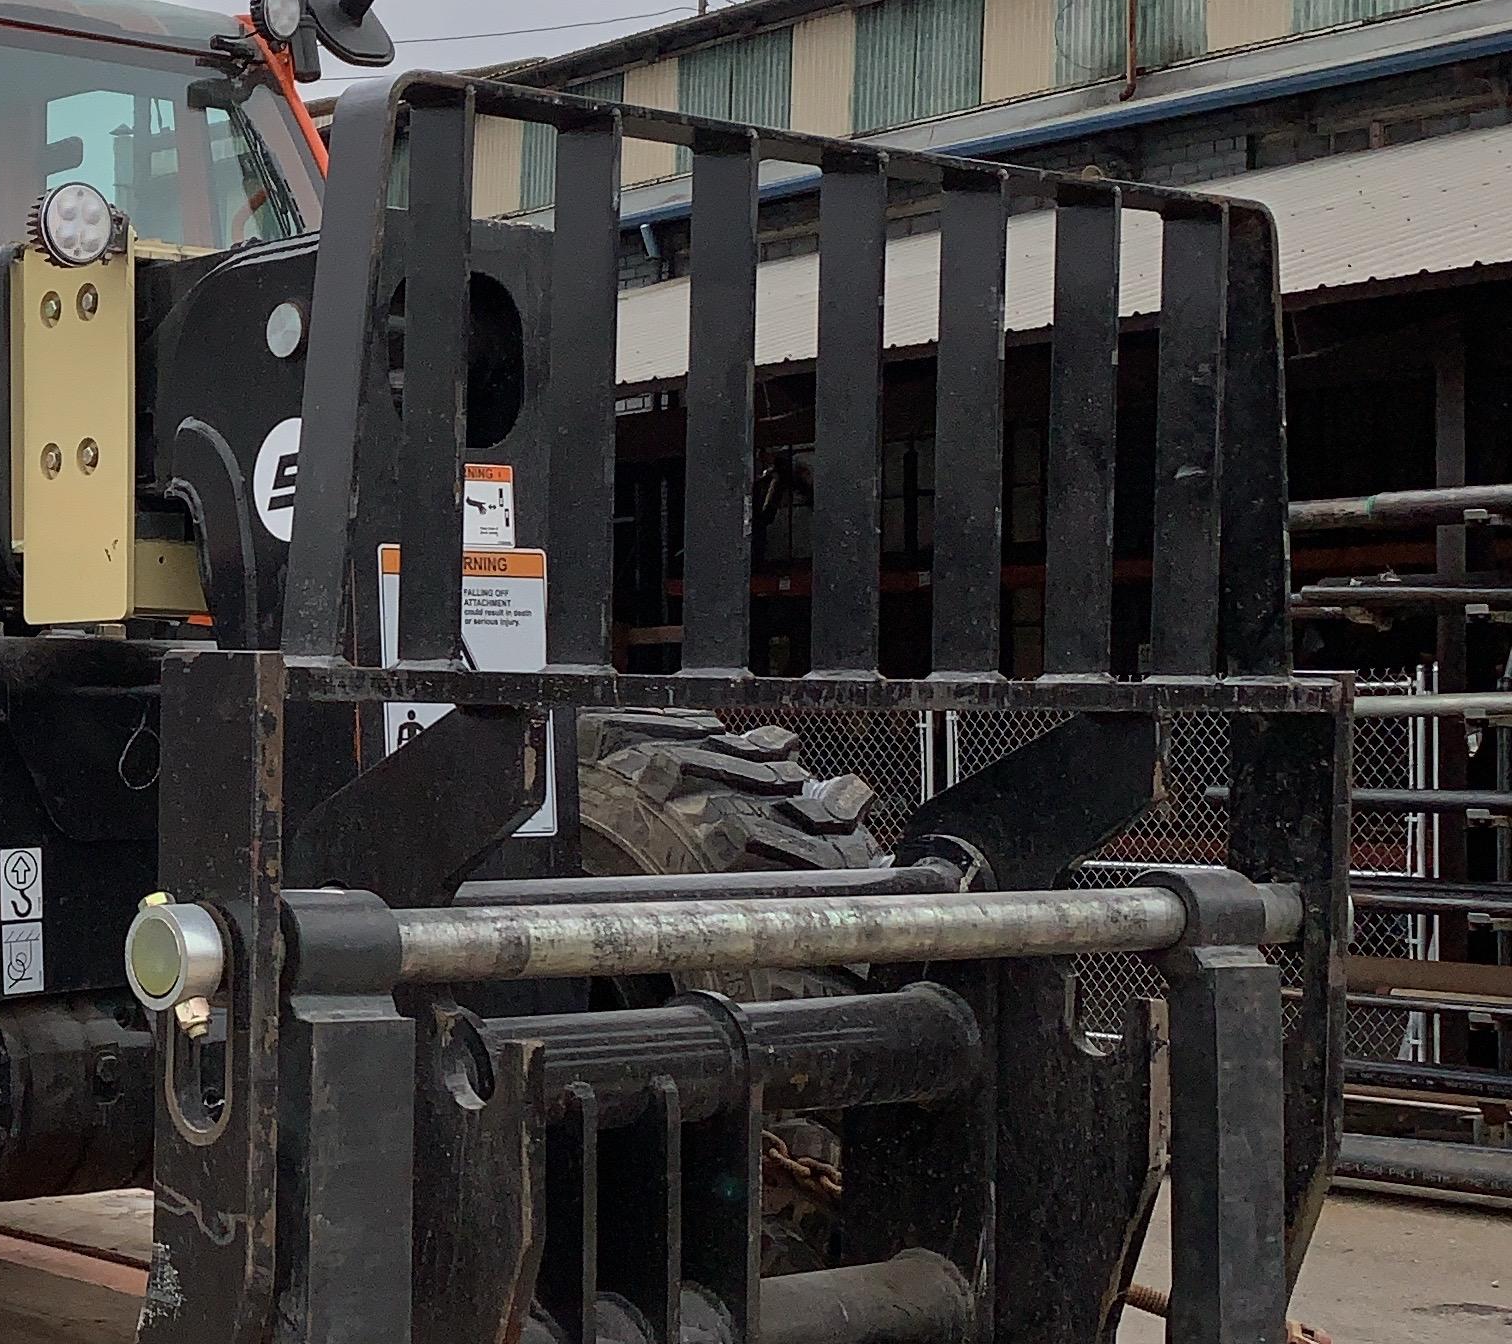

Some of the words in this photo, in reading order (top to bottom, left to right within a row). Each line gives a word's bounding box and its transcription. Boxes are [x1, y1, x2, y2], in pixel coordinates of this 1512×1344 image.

[464, 557, 508, 572] RNING
[463, 588, 493, 597] FALLING
[494, 588, 509, 597] OFF
[463, 598, 511, 607] ATTACHMENT
[464, 608, 483, 616] could
[484, 608, 504, 616] result
[513, 609, 533, 617] death
[473, 618, 499, 626] serious
